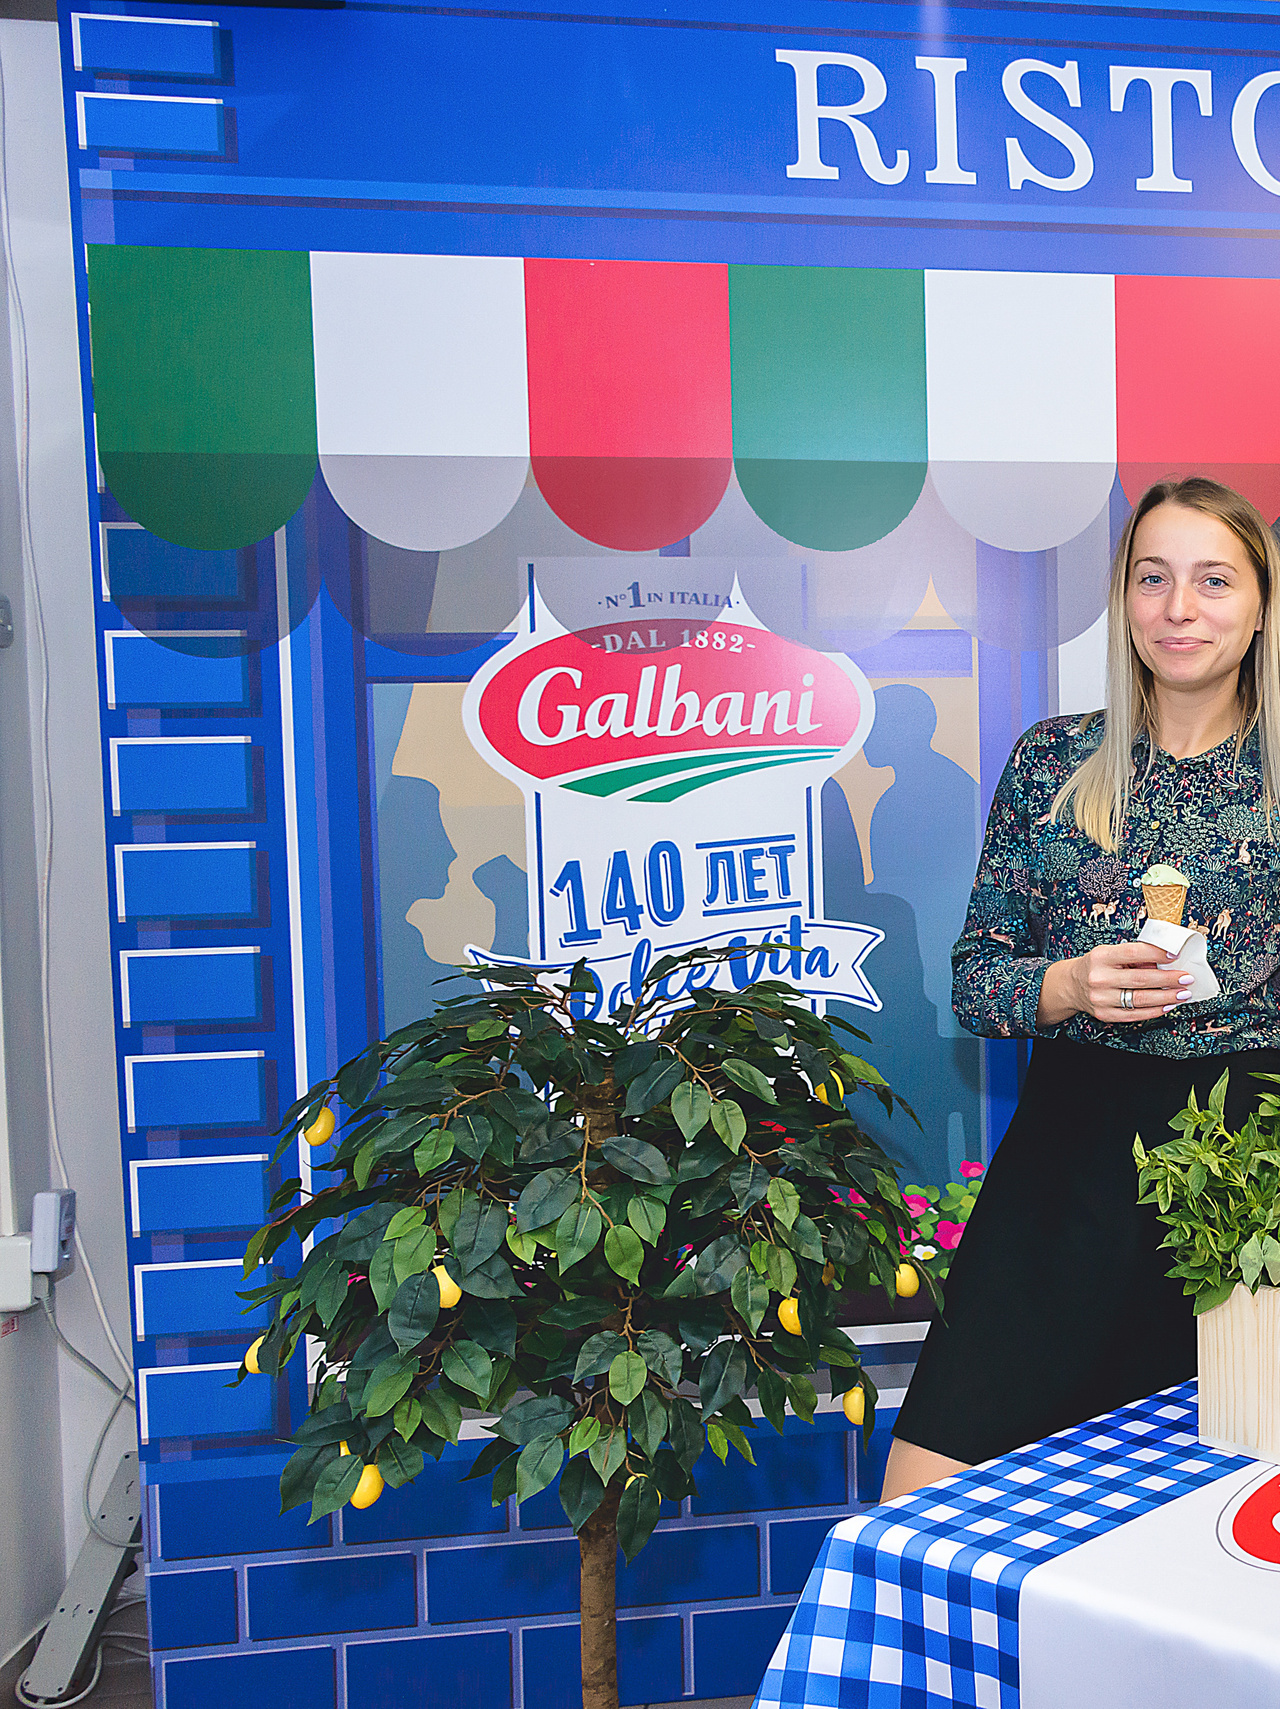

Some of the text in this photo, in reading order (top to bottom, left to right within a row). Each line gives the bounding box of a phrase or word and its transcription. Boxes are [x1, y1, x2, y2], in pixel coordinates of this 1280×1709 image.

[647, 592, 663, 603] IN
[516, 662, 824, 747] Galbani
[548, 840, 797, 949] 140 ЛЕТ
[728, 914, 839, 991] Vita
